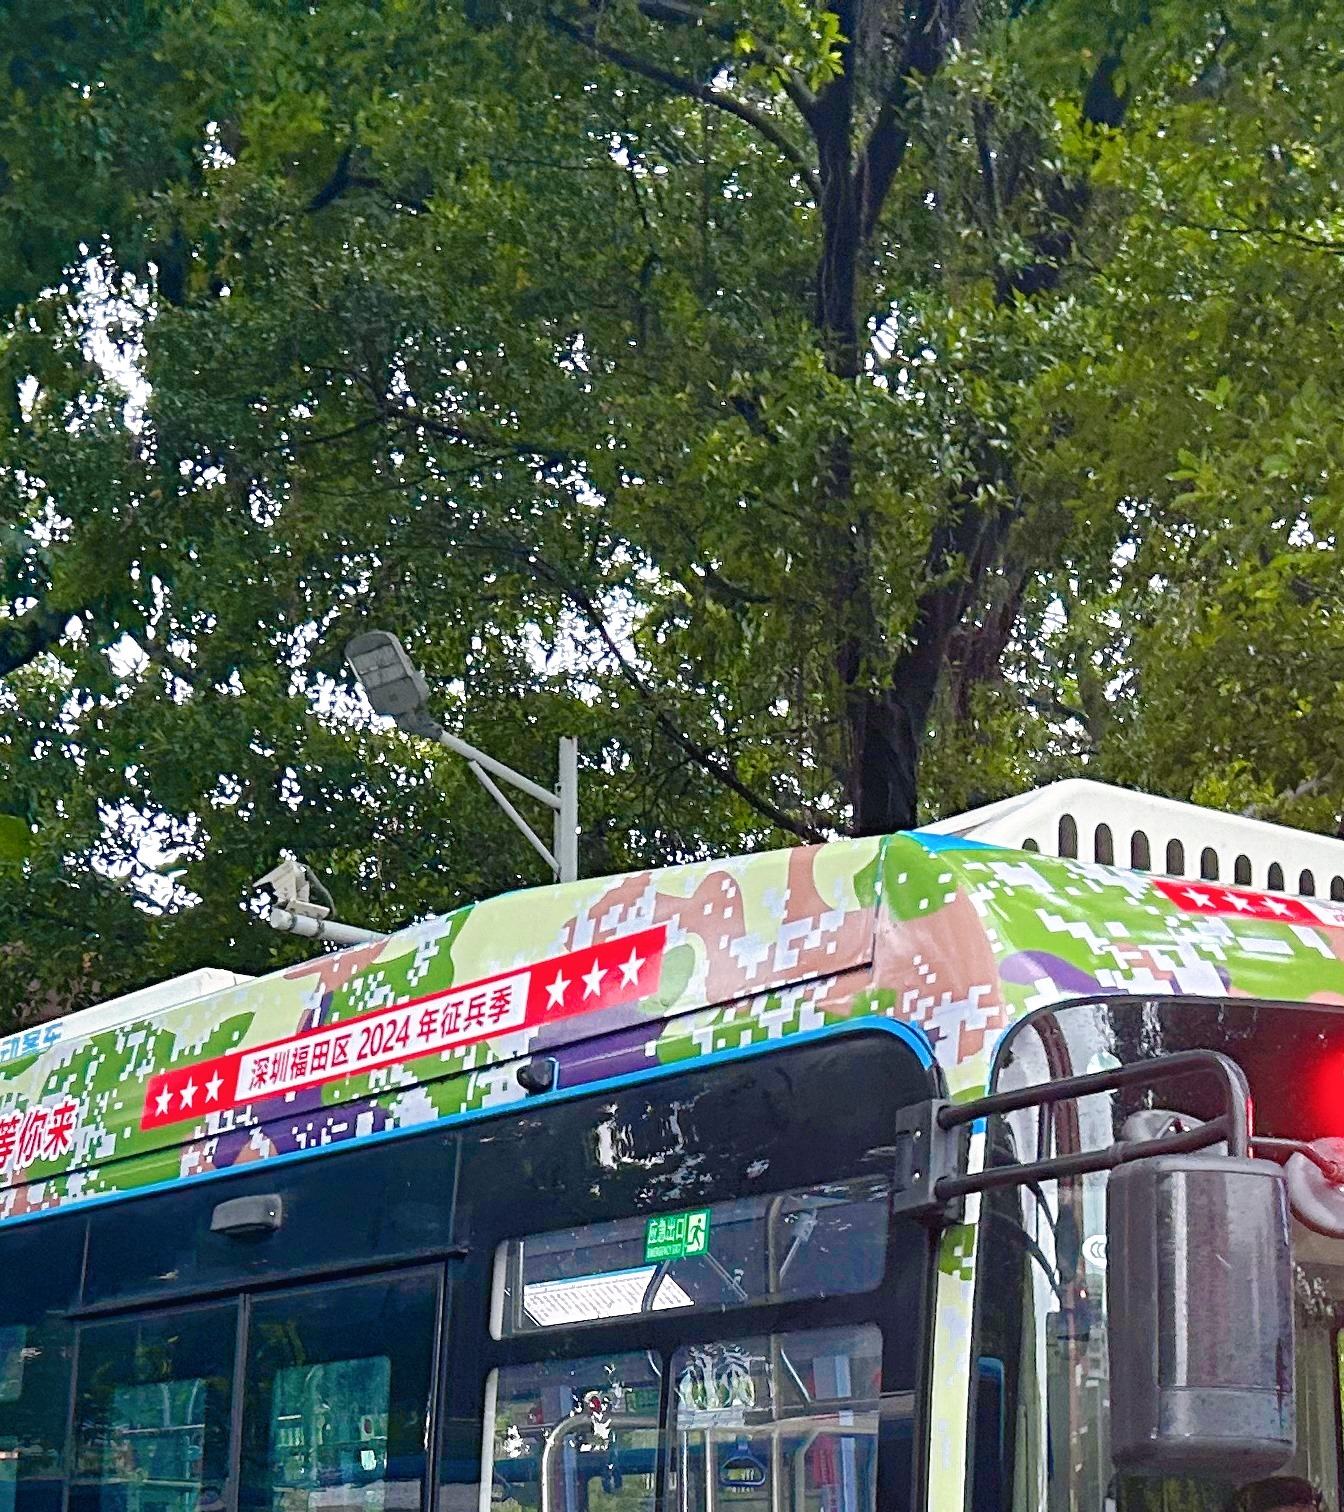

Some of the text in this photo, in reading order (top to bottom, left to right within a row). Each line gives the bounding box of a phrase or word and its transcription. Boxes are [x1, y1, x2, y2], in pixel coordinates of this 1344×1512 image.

[250, 984, 514, 1092] 深圳福田区 2024 年征兵季
